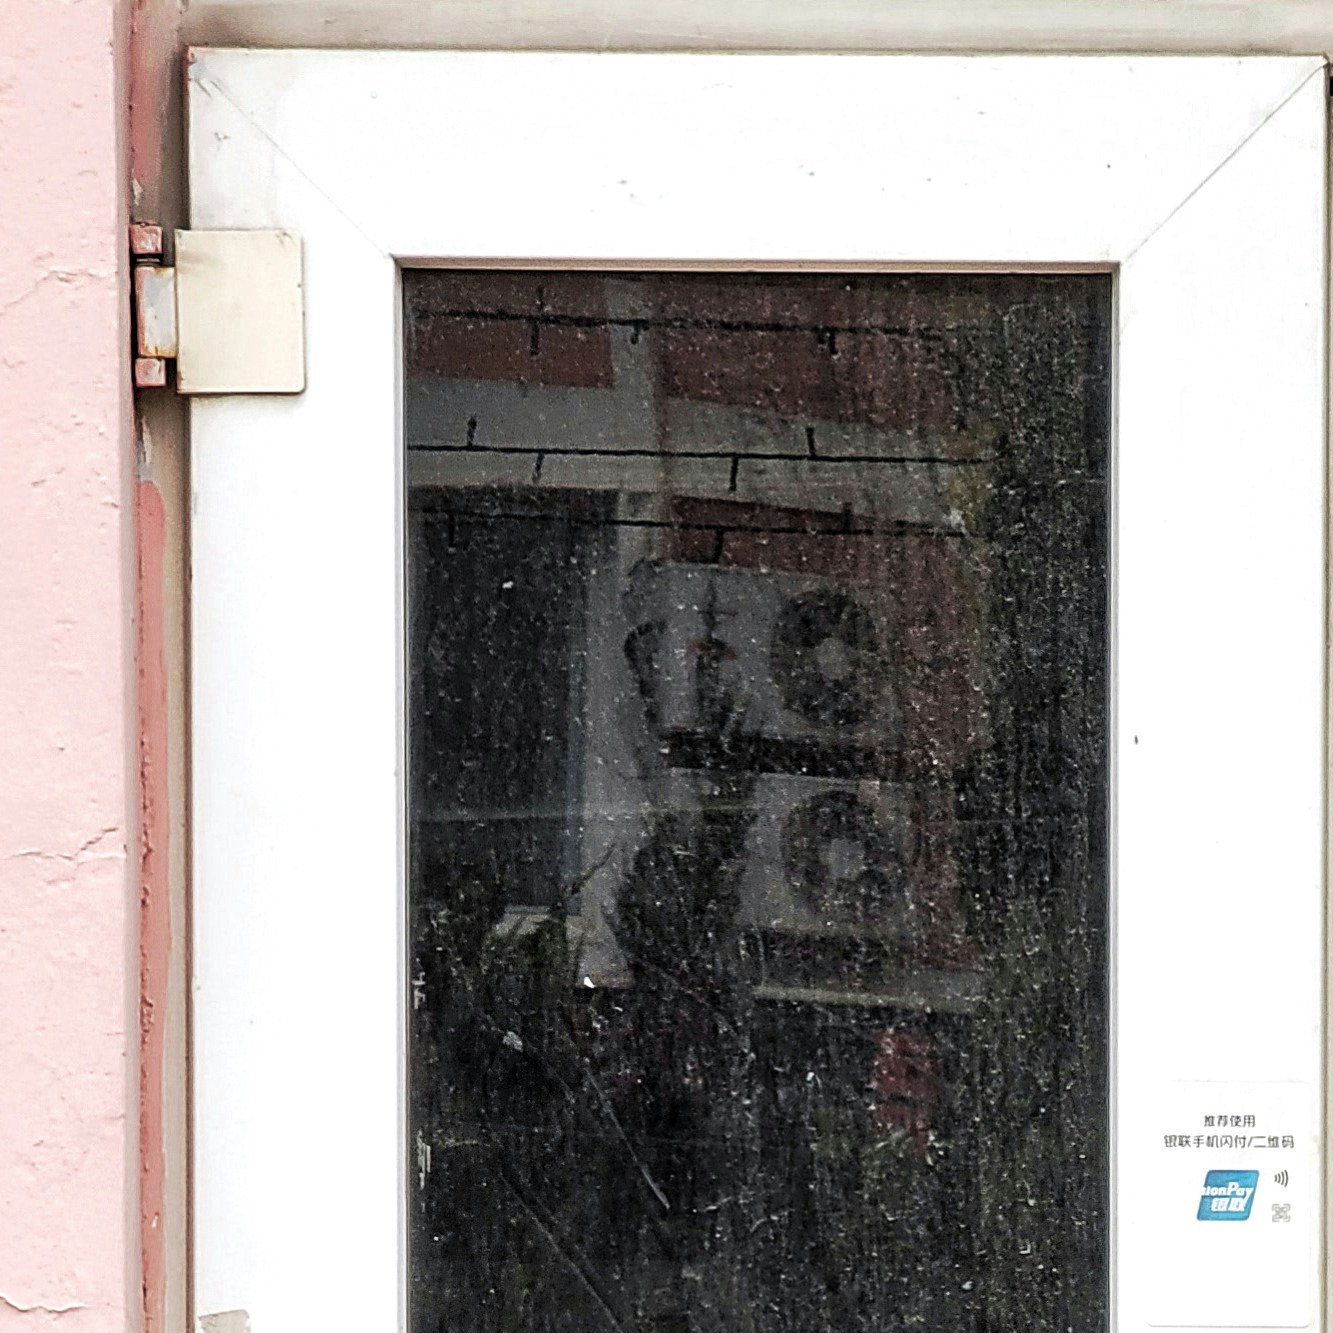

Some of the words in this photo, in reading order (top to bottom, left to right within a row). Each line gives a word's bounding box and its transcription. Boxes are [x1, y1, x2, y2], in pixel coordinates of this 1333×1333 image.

[1204, 1115, 1256, 1128] 推荐使用
[1163, 1134, 1295, 1149] 银联手机闪付/二维码
